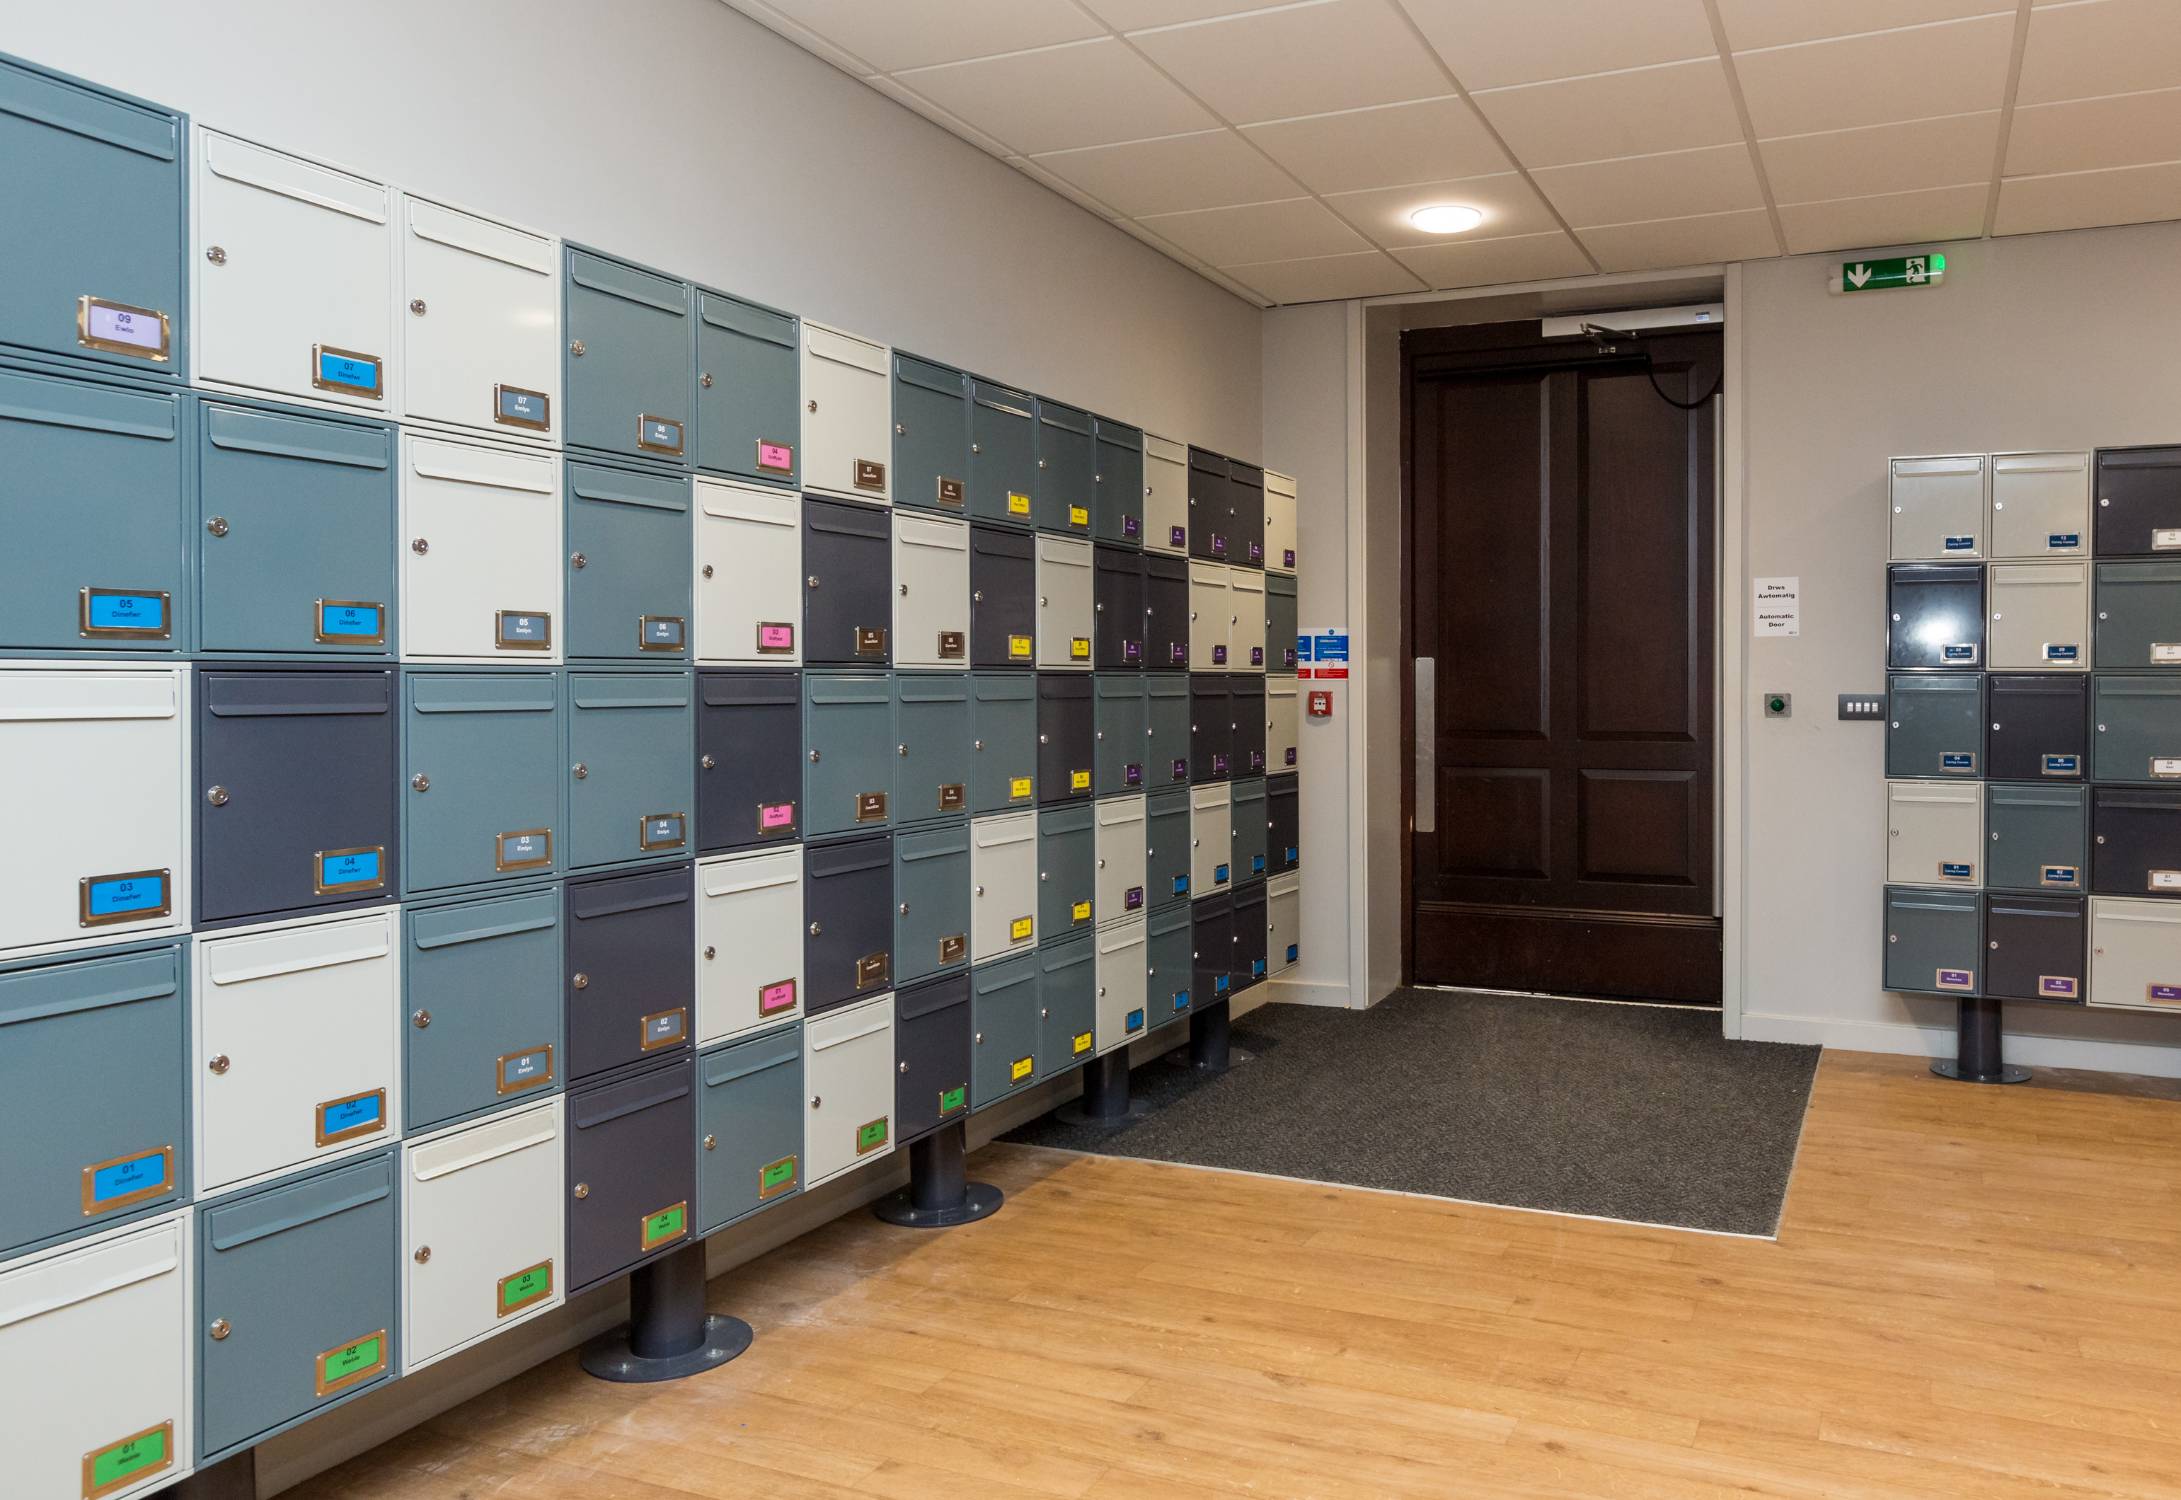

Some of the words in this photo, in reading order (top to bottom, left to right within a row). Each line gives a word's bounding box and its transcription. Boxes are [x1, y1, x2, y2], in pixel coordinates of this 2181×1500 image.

[118, 313, 132, 324] 09
[344, 362, 354, 371] 07
[518, 396, 528, 405] 07
[120, 600, 134, 609] 05
[345, 609, 356, 618] 06
[520, 836, 530, 844] 03
[344, 856, 356, 866] 04
[120, 882, 134, 892] 03
[520, 1056, 530, 1066] 01
[346, 1100, 358, 1110] 02
[122, 1163, 136, 1175] 01
[522, 1274, 532, 1284] 03
[346, 1344, 358, 1356] 02
[122, 1442, 136, 1455] 01
